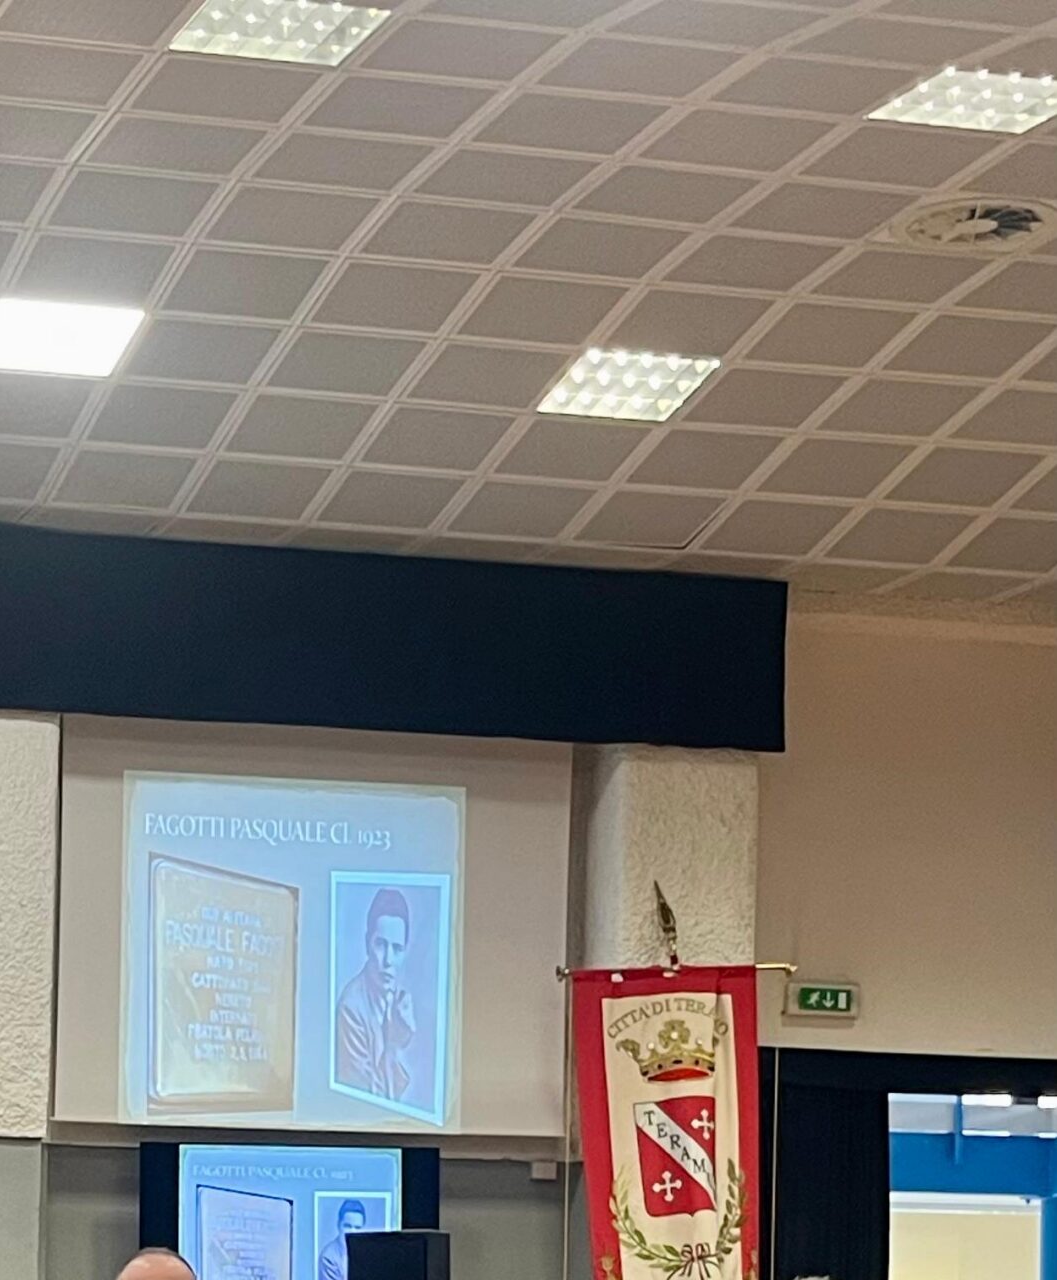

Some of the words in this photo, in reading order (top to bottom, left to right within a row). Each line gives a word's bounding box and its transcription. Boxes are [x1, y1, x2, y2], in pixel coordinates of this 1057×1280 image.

[145, 812, 224, 838] FAGOTTI
[230, 817, 327, 846] PASQUALE
[358, 829, 391, 850] 1923
[651, 999, 672, 1016] DI
[673, 997, 729, 1036] TERAO
[644, 1110, 711, 1185] TERAM
